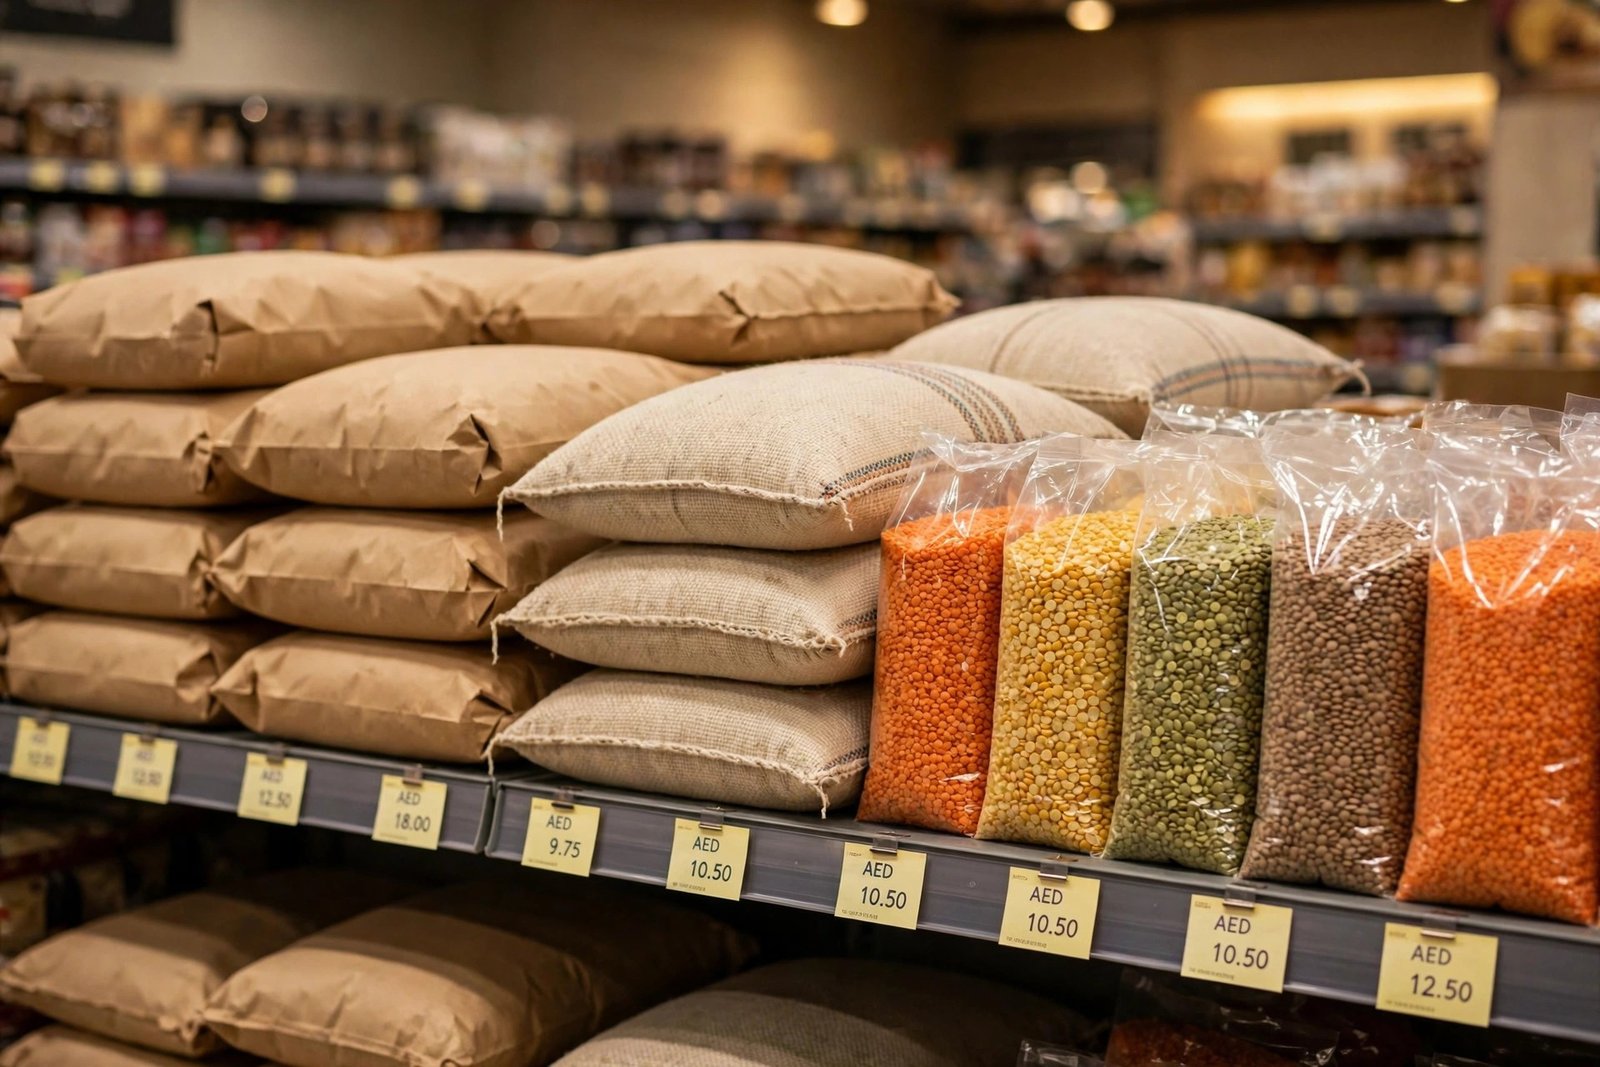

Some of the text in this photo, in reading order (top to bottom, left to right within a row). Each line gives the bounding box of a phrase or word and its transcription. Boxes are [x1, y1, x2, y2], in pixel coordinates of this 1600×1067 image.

[397, 791, 421, 806] AED
[395, 813, 431, 832] 18.00
[546, 815, 572, 830] AED
[549, 838, 581, 858] 9.75
[692, 836, 720, 853] AED
[691, 860, 732, 882] 10.50
[862, 861, 893, 879] AED
[861, 886, 907, 910] 10.50
[1029, 886, 1063, 905] AED
[1028, 913, 1078, 938] 10.50
[1214, 915, 1251, 935] AED
[1213, 943, 1269, 970] 10.50
[1410, 945, 1451, 966] AED
[1410, 973, 1473, 1003] 12.50
